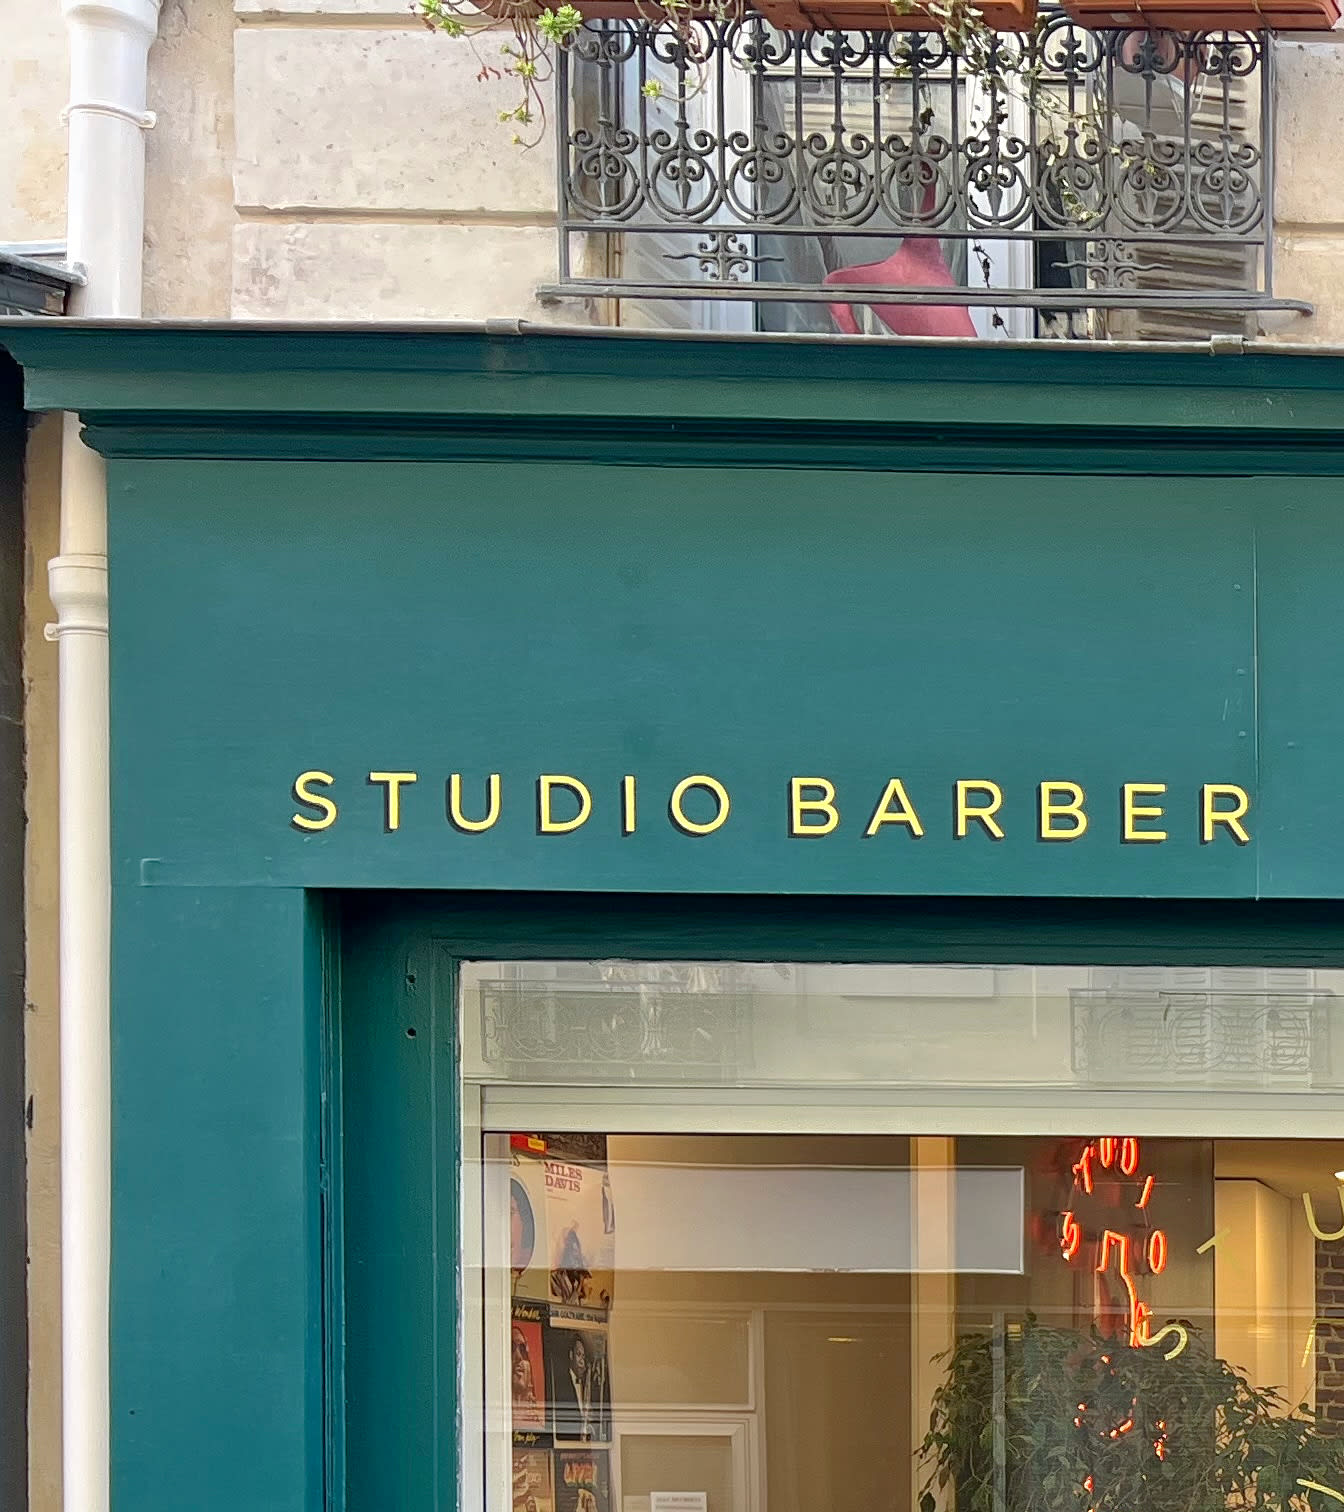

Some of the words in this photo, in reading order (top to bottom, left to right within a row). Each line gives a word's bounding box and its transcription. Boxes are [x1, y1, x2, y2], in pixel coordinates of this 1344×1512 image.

[290, 769, 732, 837] STUDIO
[786, 776, 1252, 844] BARBER
[544, 1161, 583, 1181] MILES
[545, 1174, 581, 1193] DAVIS
